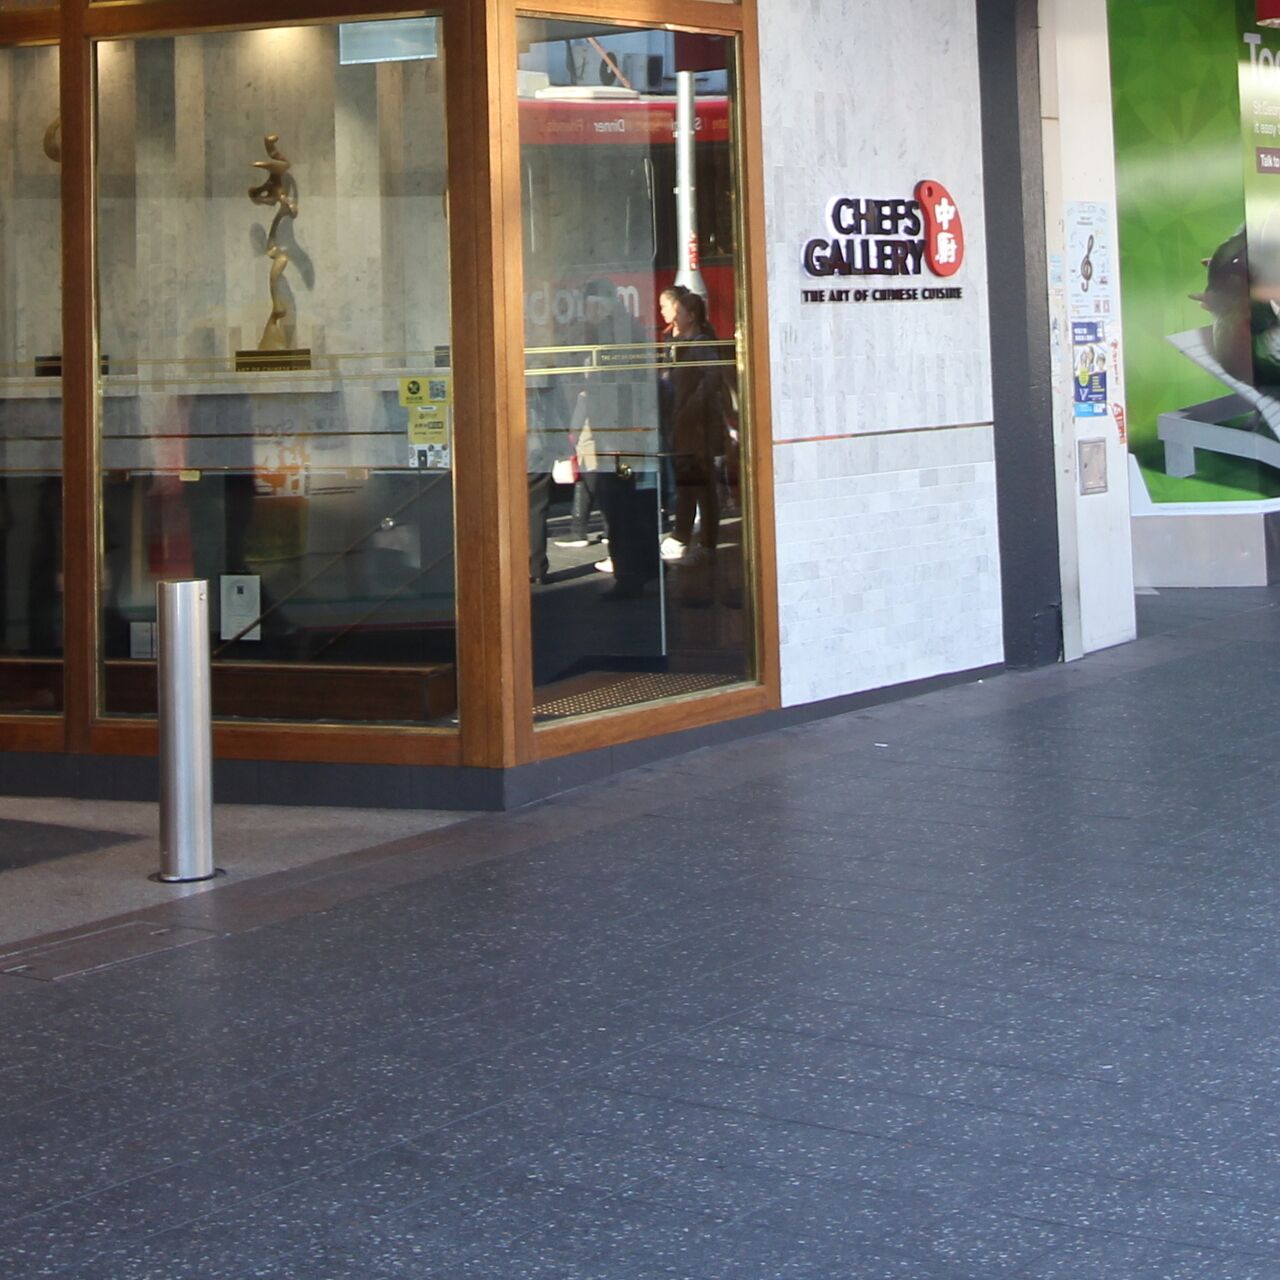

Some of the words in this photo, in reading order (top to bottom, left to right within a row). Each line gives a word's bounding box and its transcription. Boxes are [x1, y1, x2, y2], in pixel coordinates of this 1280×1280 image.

[831, 198, 921, 236] CHEFS
[804, 239, 926, 277] GALLERY
[802, 290, 825, 302] THE
[828, 289, 850, 302] ART
[853, 289, 869, 302] OF
[872, 288, 918, 300] CHINESE
[921, 287, 962, 300] CUISINE
